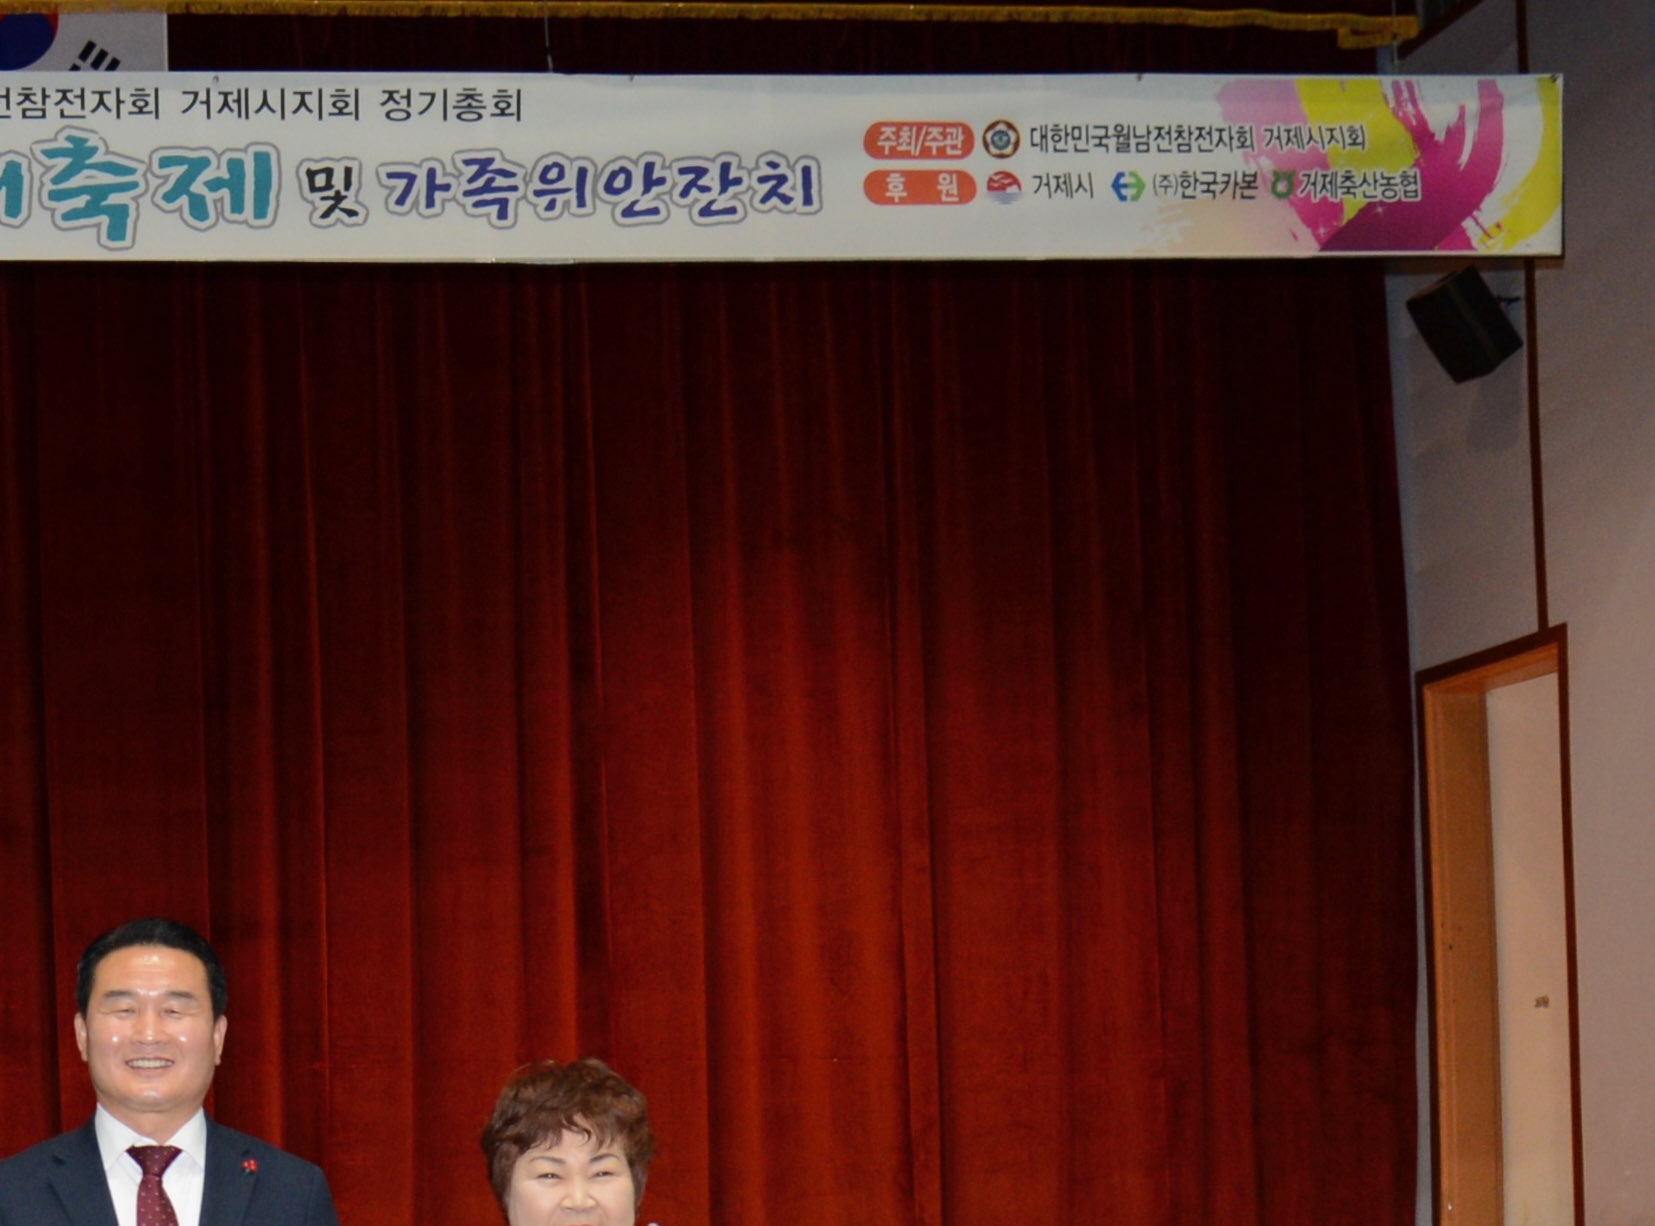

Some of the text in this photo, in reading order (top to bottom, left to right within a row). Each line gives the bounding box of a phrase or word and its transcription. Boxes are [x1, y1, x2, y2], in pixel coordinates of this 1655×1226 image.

[182, 87, 361, 122] 거제시지회
[380, 87, 524, 122] 정기총회
[877, 123, 1367, 156] 주최/주관 대한민국월남전참전자회 거제시지회
[305, 165, 361, 219] 및
[385, 155, 815, 221] 가족위안잔치
[1033, 172, 1095, 200] 거제시
[1152, 170, 1259, 200] (주)한국카본
[1299, 169, 1420, 200] 거제축산농협
